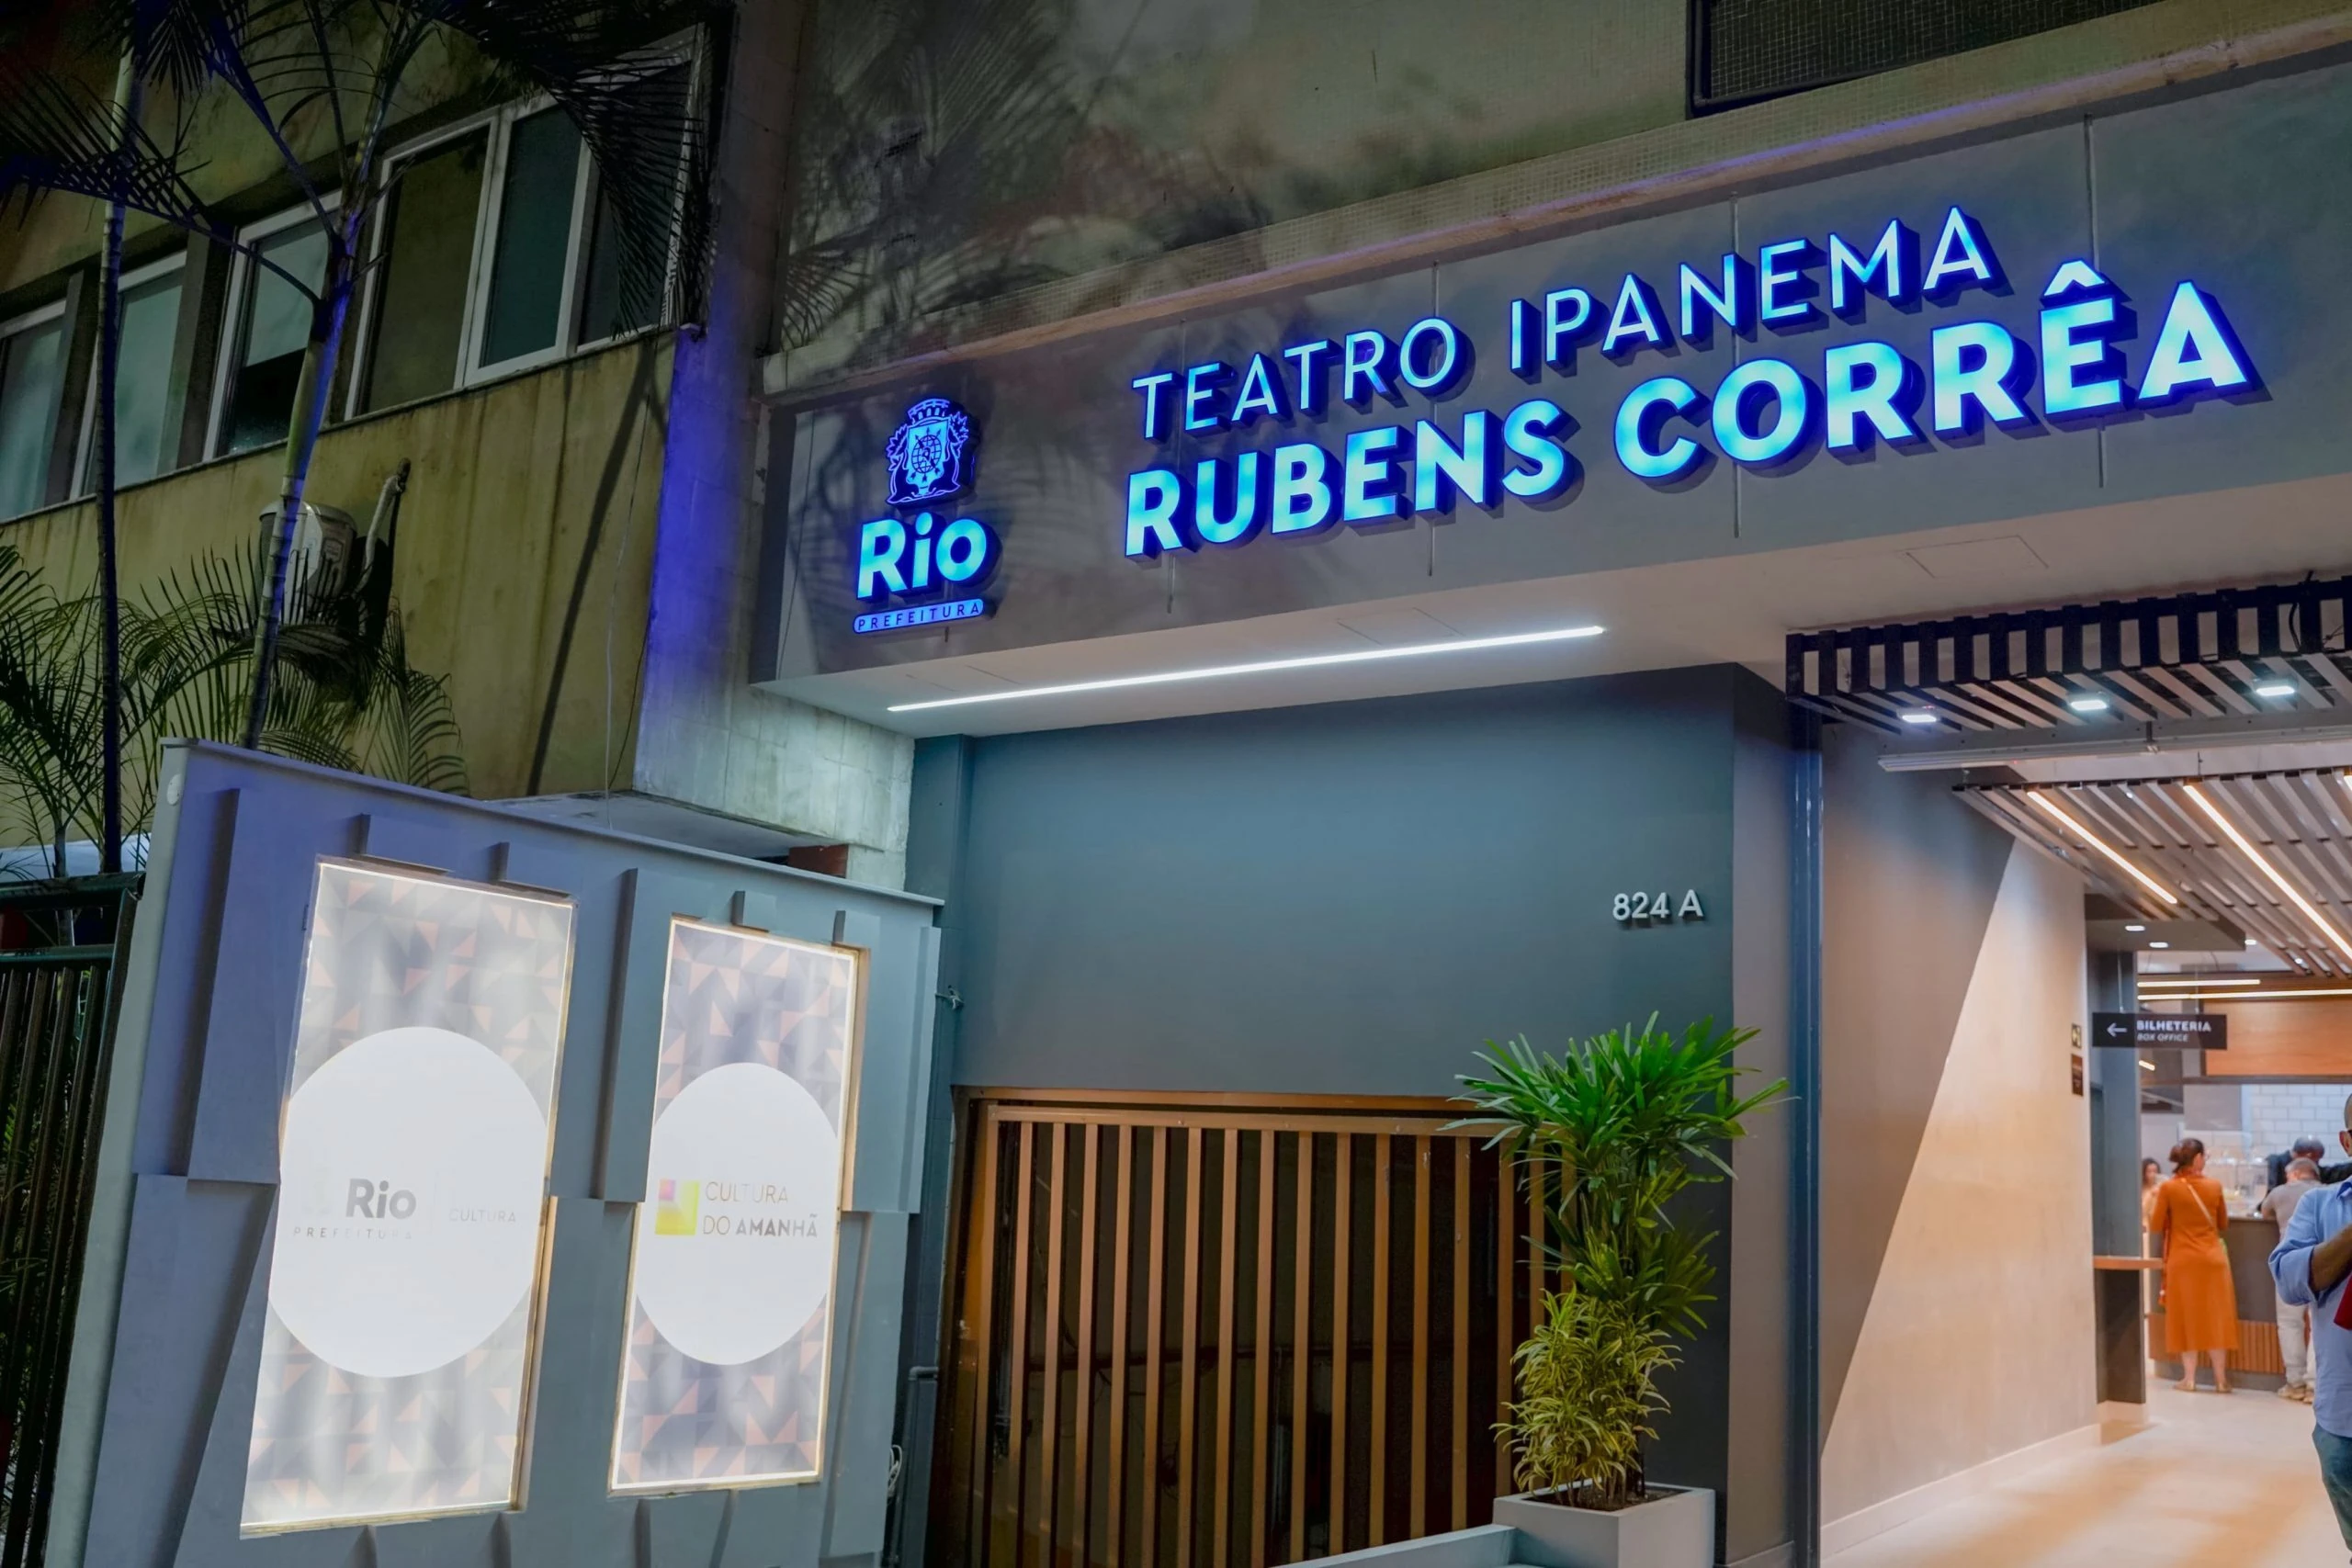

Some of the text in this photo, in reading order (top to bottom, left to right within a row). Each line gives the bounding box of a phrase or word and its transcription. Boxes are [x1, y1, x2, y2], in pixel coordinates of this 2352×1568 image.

[1133, 206, 1992, 440] TEATRO IPANEMA
[1125, 259, 2248, 557] RUBENS CORRÊA
[857, 512, 987, 599] Rio
[857, 603, 979, 631] PREFEITURA
[1612, 888, 1704, 920] 824 A
[2136, 1020, 2212, 1032] BILHETERIA
[2137, 1033, 2188, 1043] BOX OFFICE
[345, 1178, 417, 1219] Rio
[705, 1181, 788, 1203] CULTURA
[449, 1207, 516, 1224] CULTURA
[703, 1213, 818, 1237] DO AMANHÃ
